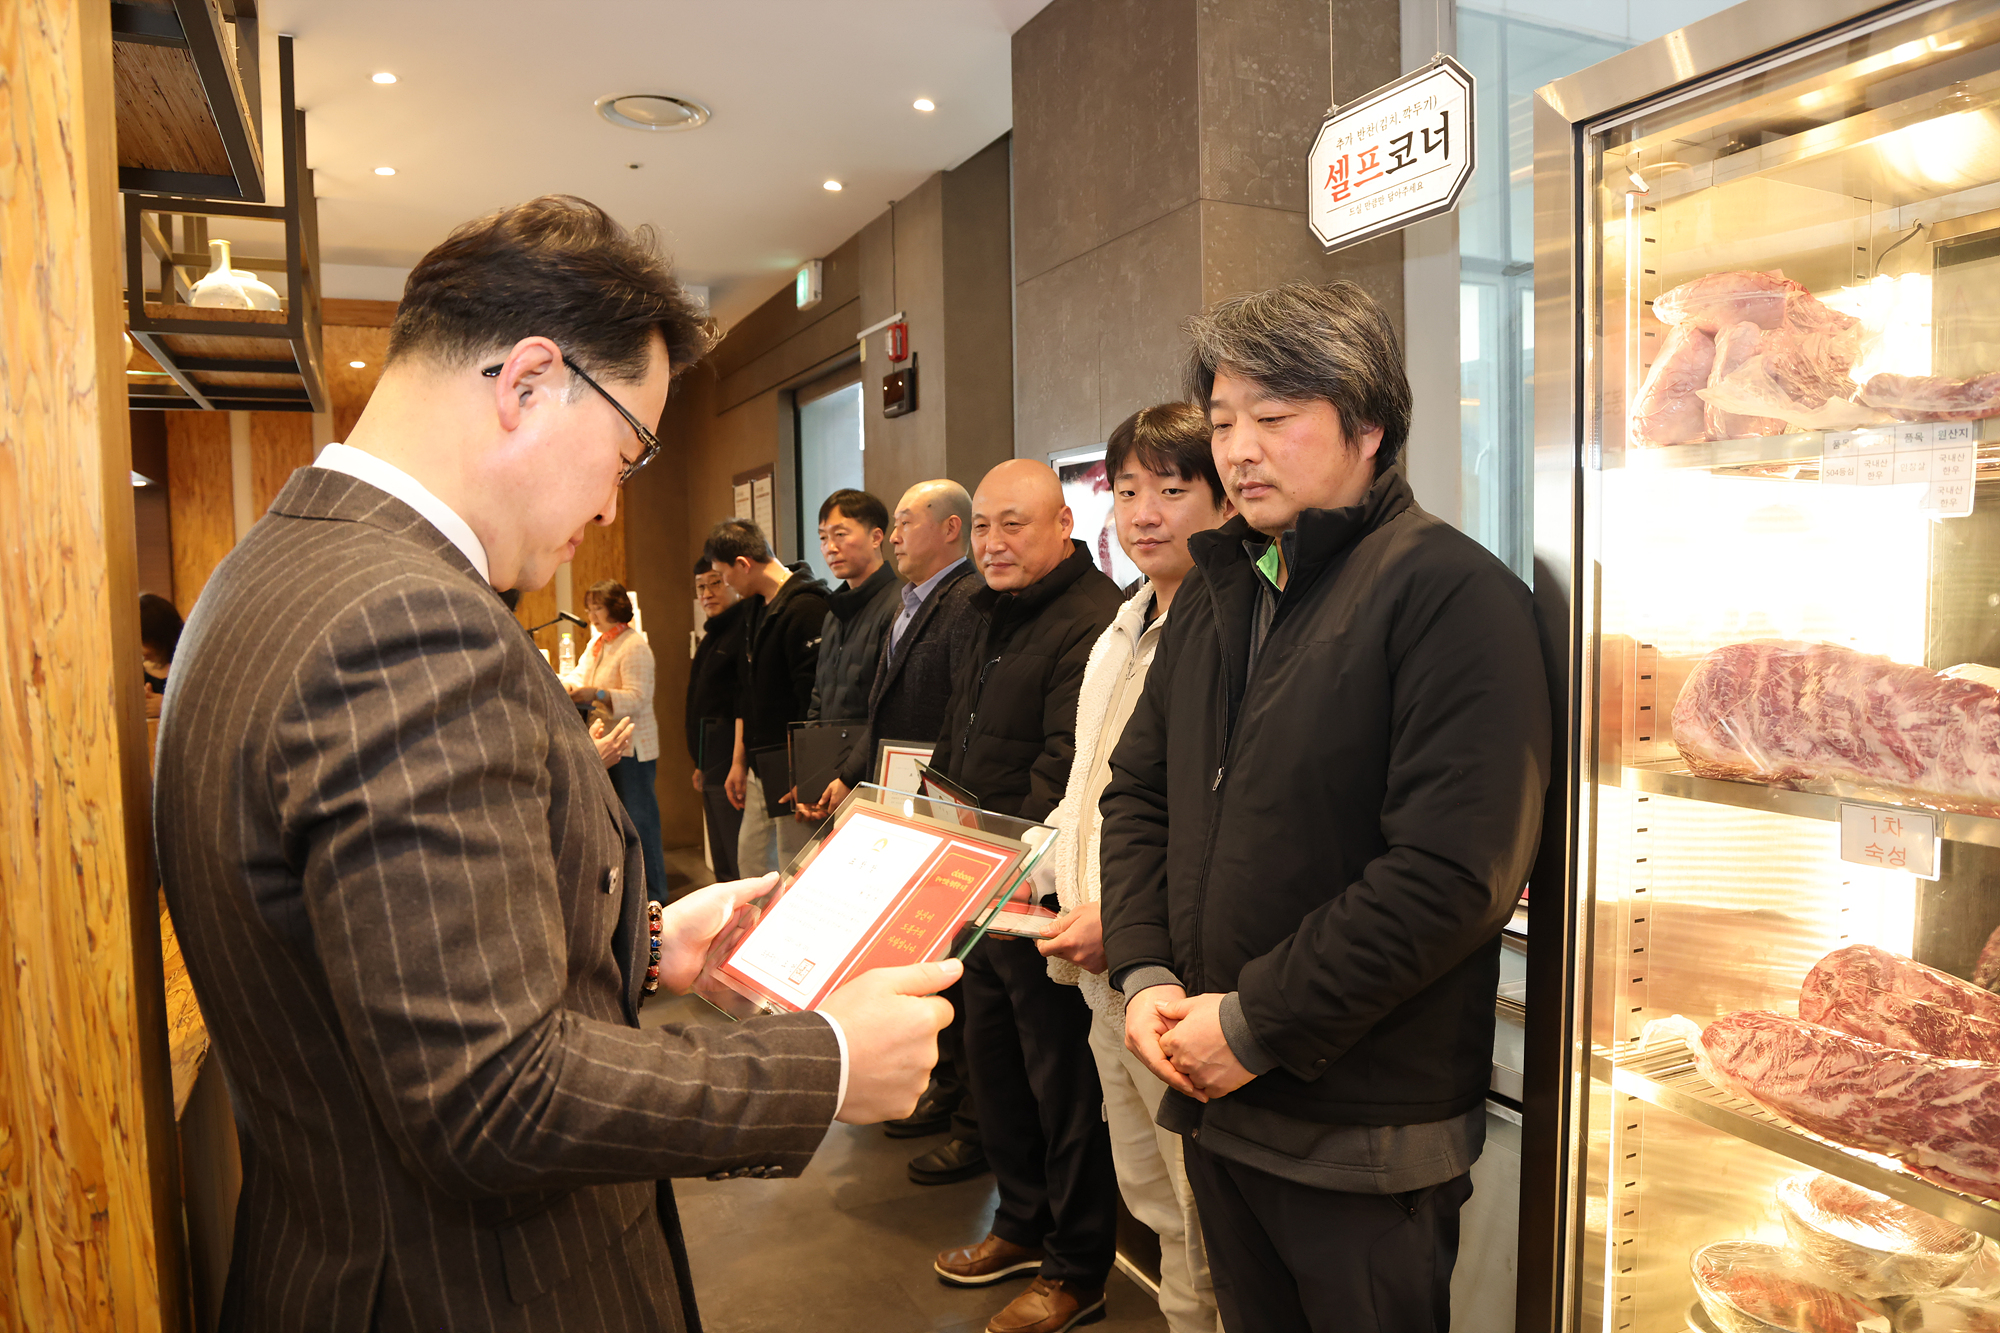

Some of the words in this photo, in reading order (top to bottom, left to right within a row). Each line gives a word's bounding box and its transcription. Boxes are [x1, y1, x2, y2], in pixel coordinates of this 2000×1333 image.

[1335, 131, 1353, 151] 추가
[1403, 94, 1437, 120] 깍두기)
[1324, 110, 1450, 203] 셀프코너
[1349, 203, 1362, 217] 드실
[1364, 194, 1385, 211] 만큼만
[1832, 438, 1850, 450] 품목
[1904, 431, 1924, 443] 품목
[1937, 427, 1969, 441] 원산지
[1863, 458, 1888, 468] 국내산
[1938, 452, 1965, 463] 국내산
[1826, 466, 1854, 478] 504등심
[1867, 470, 1884, 481] 한우
[1942, 465, 1960, 476] 한우
[1937, 485, 1963, 496] 국내산
[1940, 498, 1958, 508] 한우
[1870, 815, 1904, 838] 1차
[1864, 842, 1906, 867] 숙성
[951, 869, 975, 885] dobong
